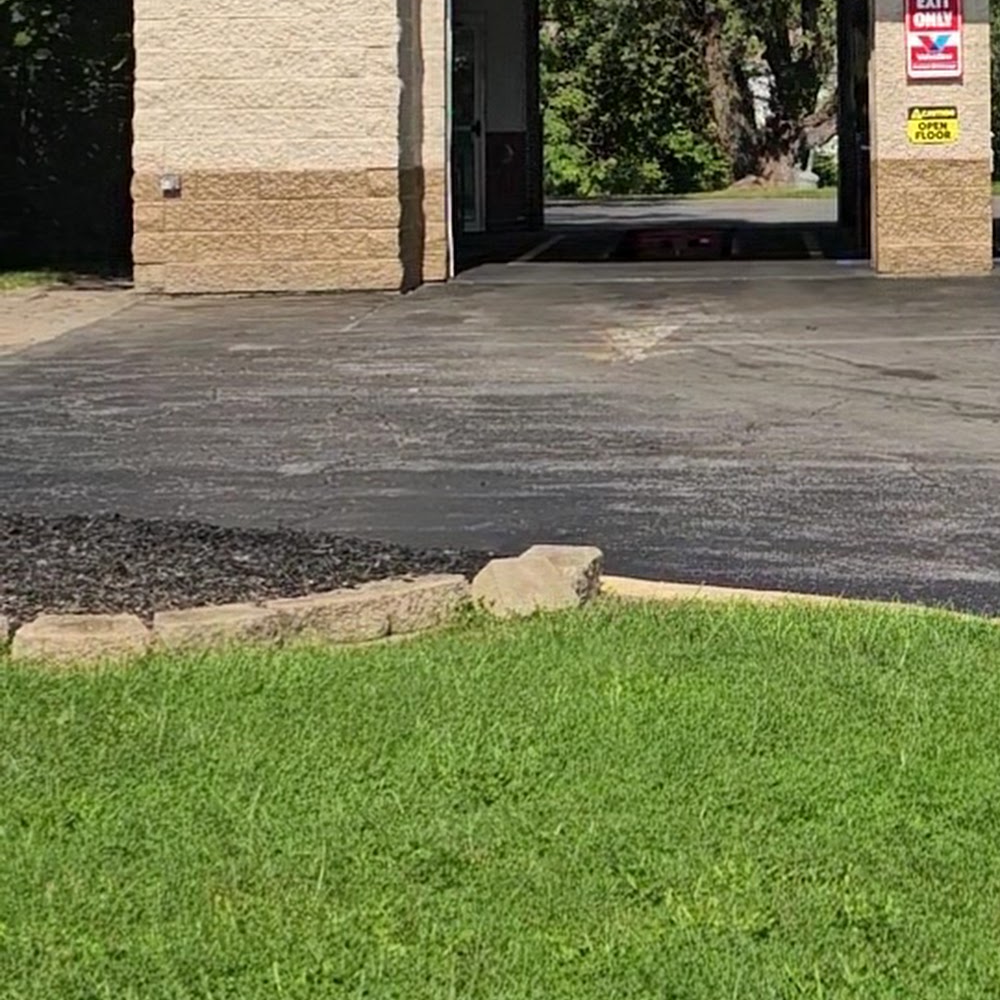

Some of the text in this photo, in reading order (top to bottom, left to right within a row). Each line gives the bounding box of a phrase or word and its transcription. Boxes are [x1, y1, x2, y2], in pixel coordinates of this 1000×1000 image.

[913, 12, 952, 28] ONLY
[918, 122, 948, 130] OPEN
[915, 131, 951, 140] FLOOR
